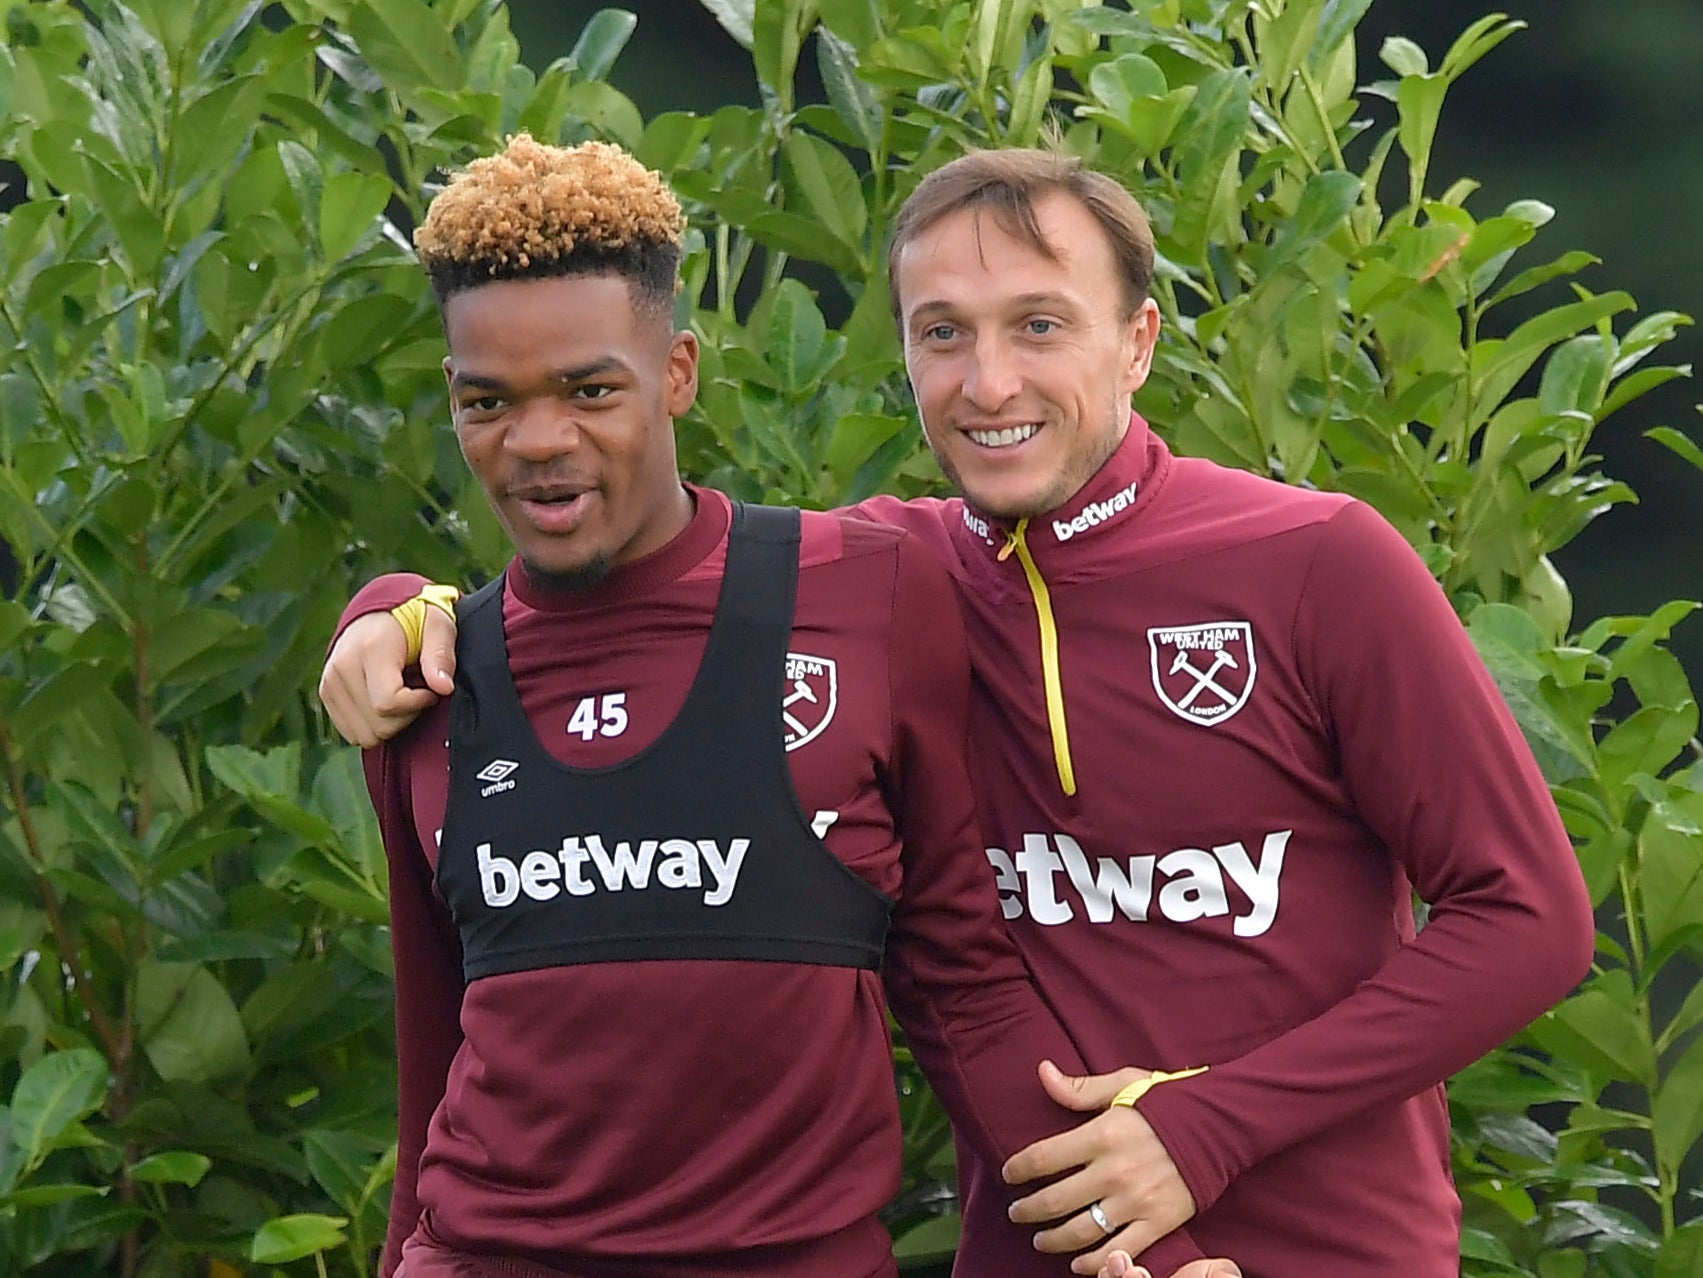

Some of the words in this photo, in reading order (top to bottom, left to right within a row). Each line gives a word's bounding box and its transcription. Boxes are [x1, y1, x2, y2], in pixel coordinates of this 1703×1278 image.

[1052, 482, 1137, 541] betway
[1160, 632, 1200, 645] WEST
[1203, 628, 1240, 641] HAM
[1176, 639, 1224, 650] UNITED
[567, 693, 628, 741] 45
[1190, 703, 1227, 716] LONDON
[481, 779, 516, 798] umbro
[476, 835, 750, 907] betway
[985, 829, 1293, 937] etway
